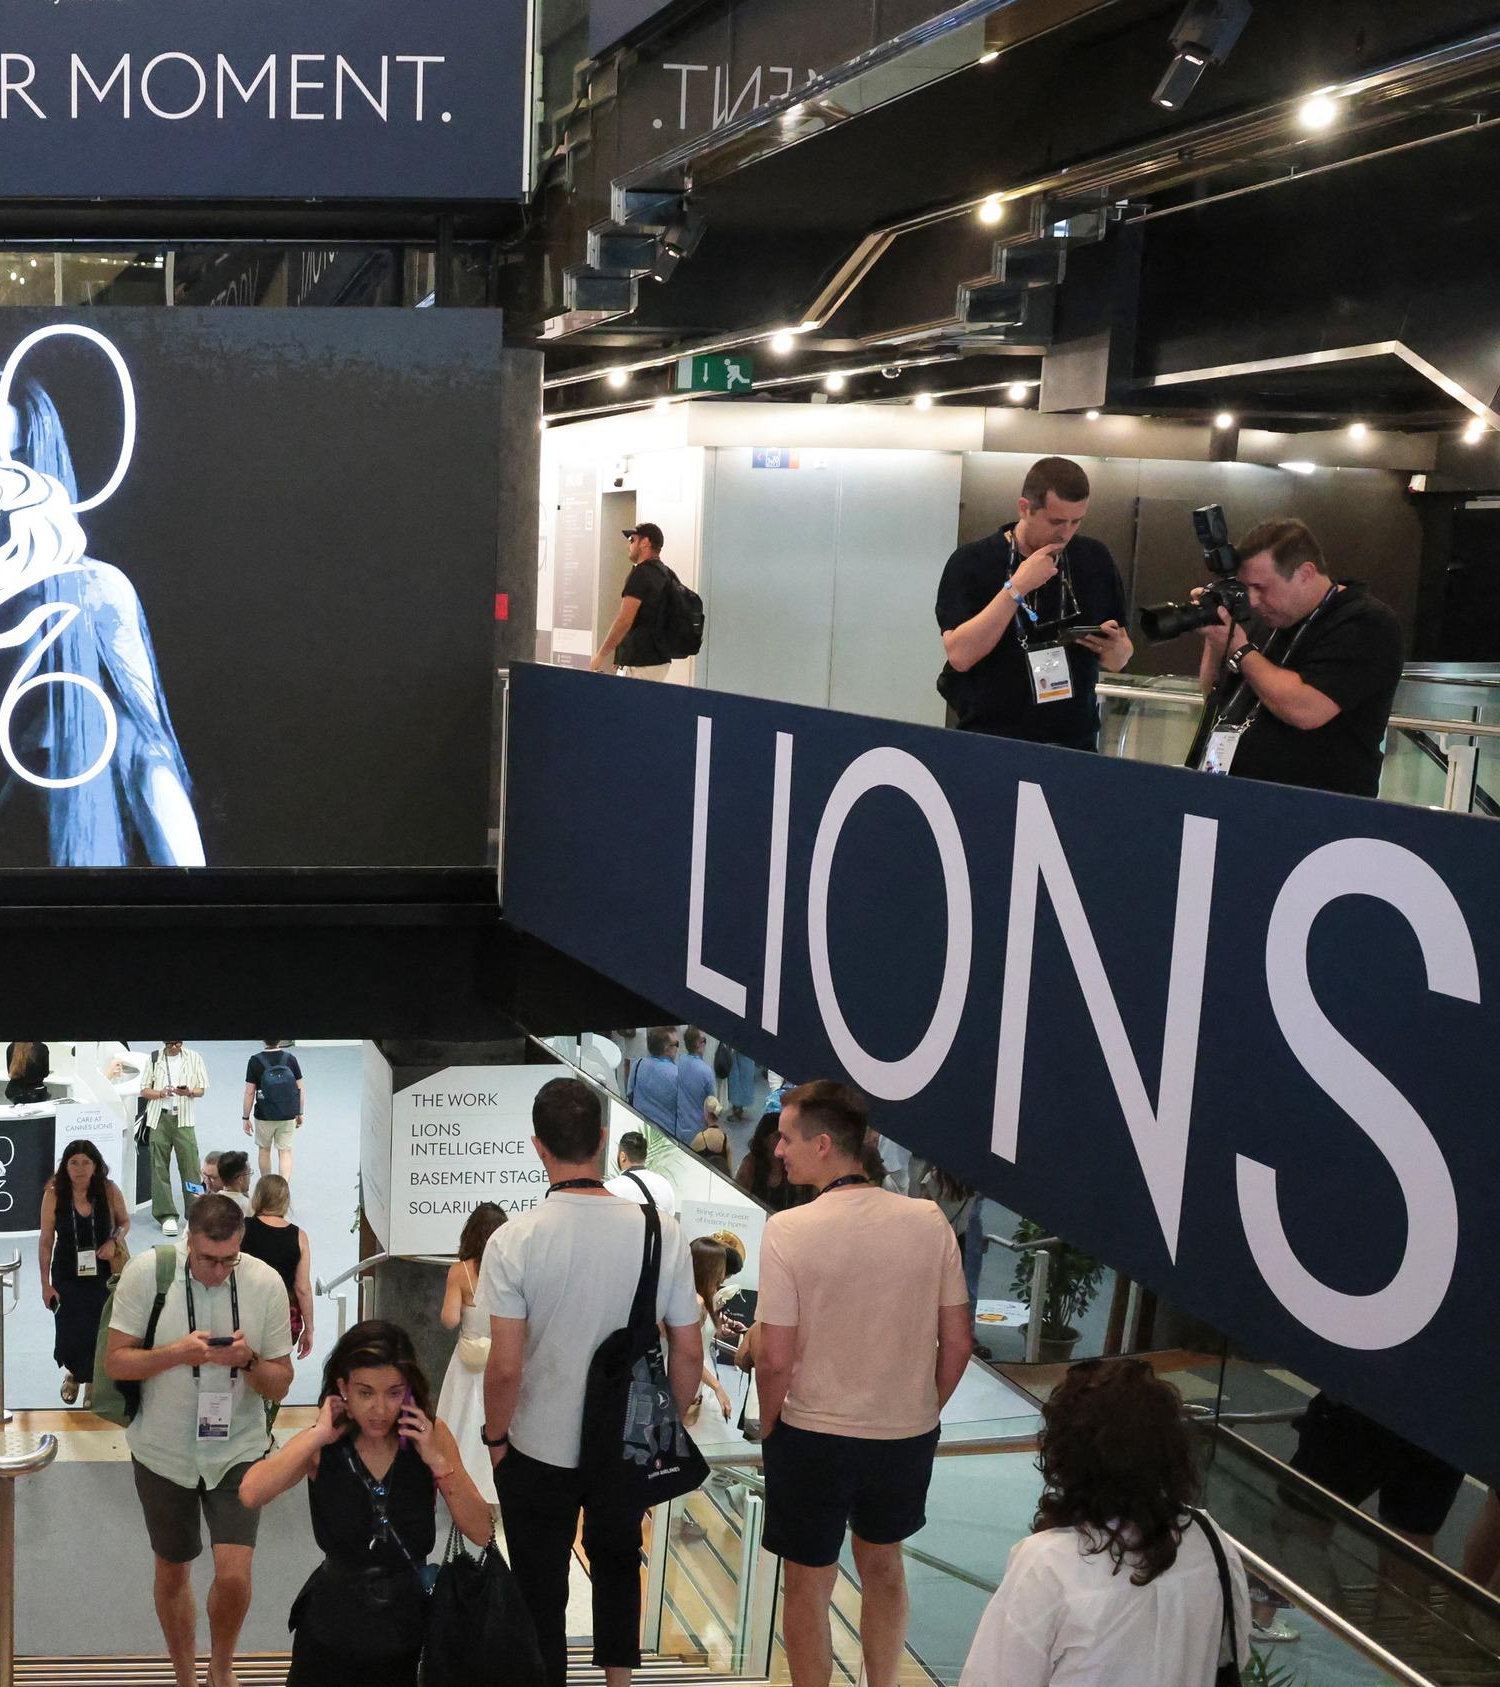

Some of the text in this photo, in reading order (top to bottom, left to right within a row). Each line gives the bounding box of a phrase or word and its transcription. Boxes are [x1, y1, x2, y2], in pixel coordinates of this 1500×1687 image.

[70, 52, 452, 122] MOMENT.
[686, 715, 1480, 1350] LIONS
[411, 1093, 498, 1107] THE WORK
[65, 1122, 113, 1132] CANNES LIONS
[411, 1123, 461, 1137] LIONS
[411, 1141, 524, 1156] INTELLIGENCE
[410, 1169, 549, 1185] BASEMENT STAGE
[409, 1201, 493, 1215] SOLARIU
[696, 1207, 714, 1218] Bring
[715, 1210, 730, 1219] your
